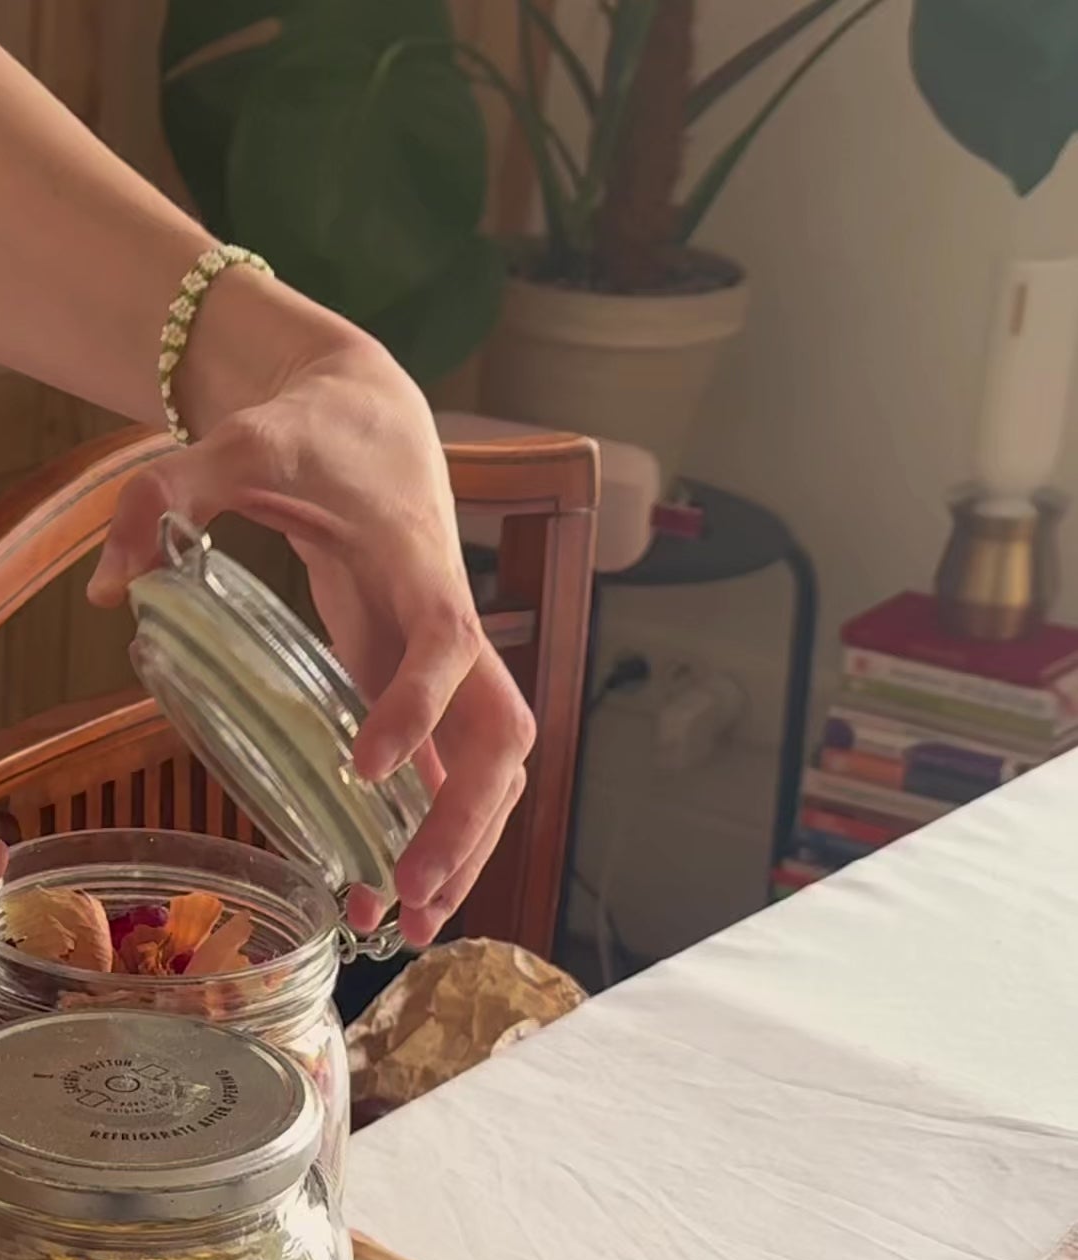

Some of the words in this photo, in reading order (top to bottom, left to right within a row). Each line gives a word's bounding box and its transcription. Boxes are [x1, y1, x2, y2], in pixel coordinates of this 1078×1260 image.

[79, 1059, 133, 1074] BUTTON
[89, 1123, 198, 1141] REFRIGERATE
[198, 1105, 232, 1129] AFTER
[215, 1068, 240, 1106] OPENING
